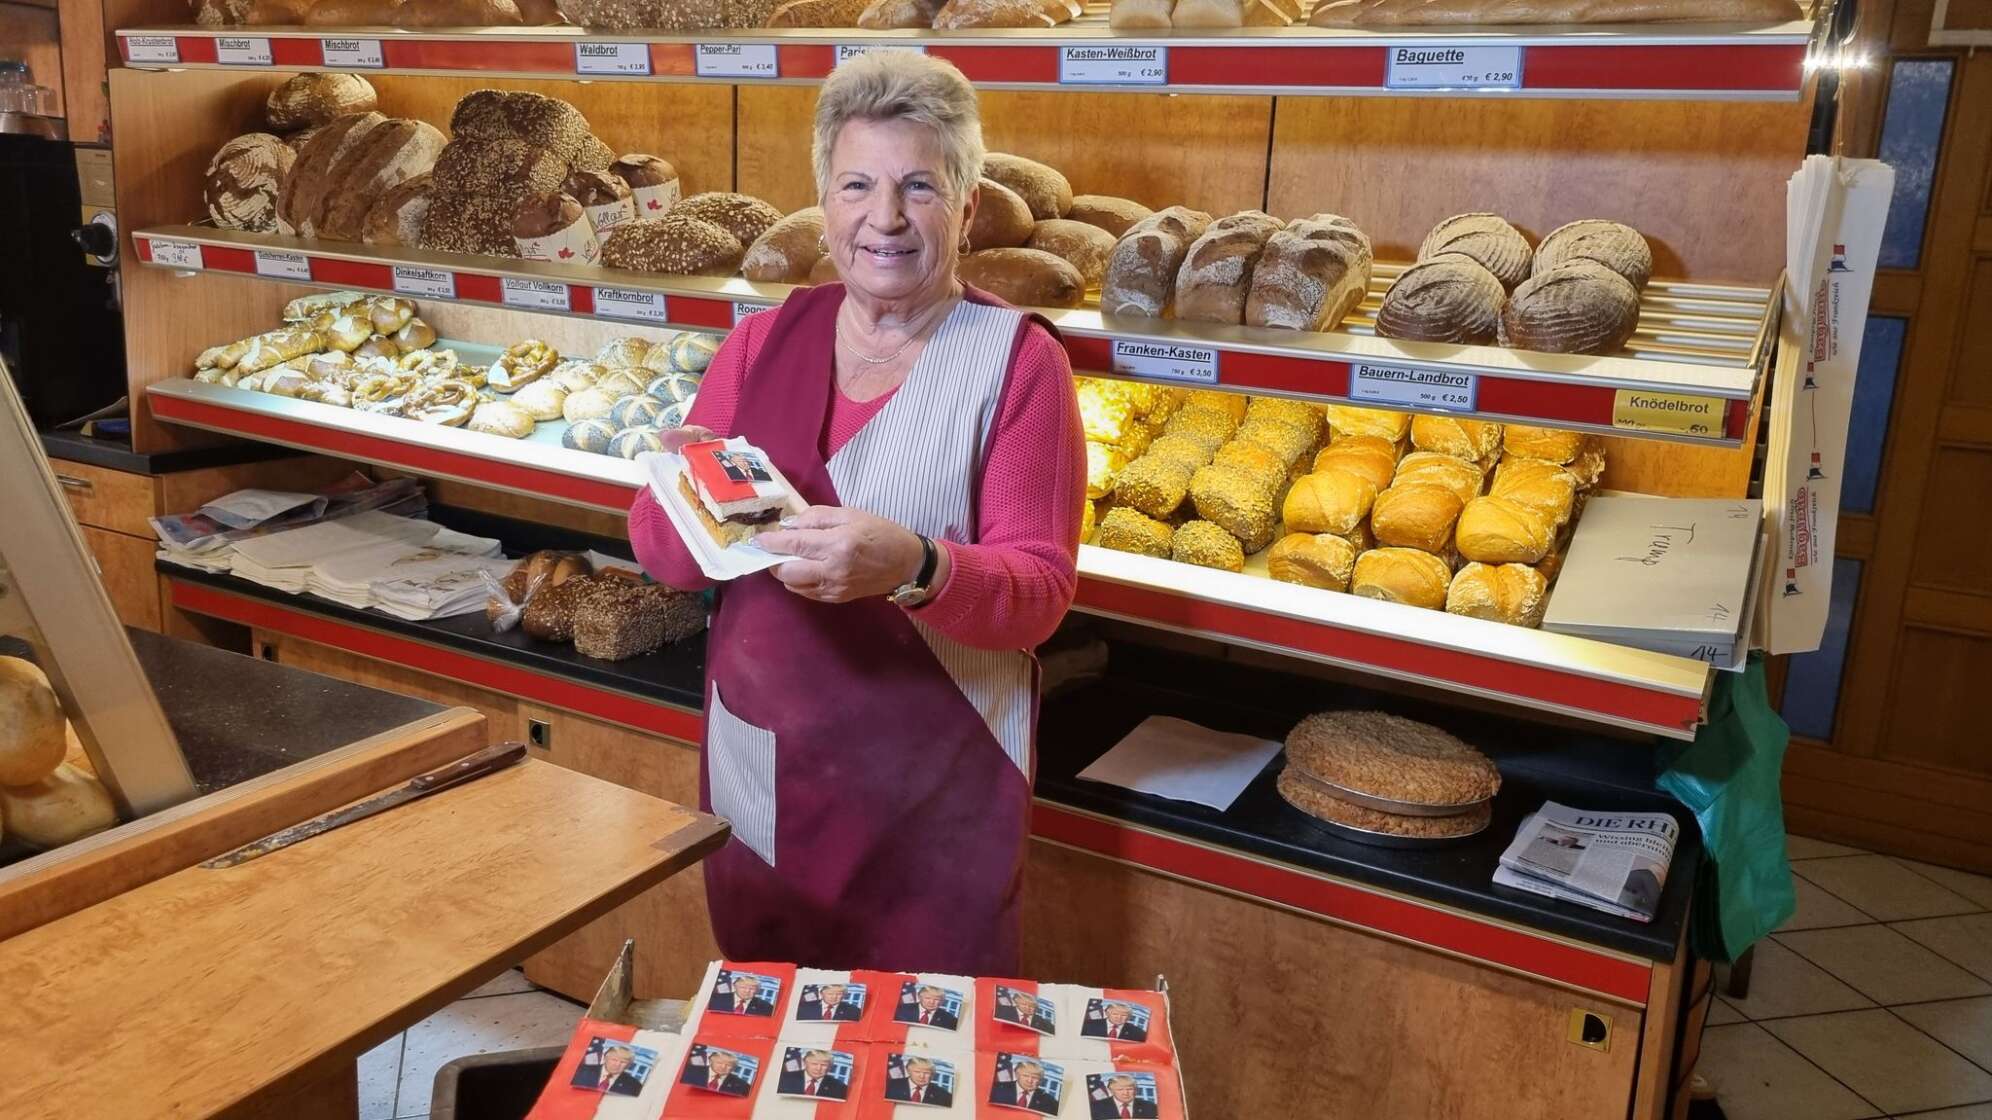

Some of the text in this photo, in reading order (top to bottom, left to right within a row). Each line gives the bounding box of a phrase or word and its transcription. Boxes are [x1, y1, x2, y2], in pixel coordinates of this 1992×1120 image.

[325, 40, 360, 49] Mischbrot
[579, 45, 618, 55] Waldbrot
[1066, 48, 1157, 60] Kasten-Weißbrot
[1396, 48, 1465, 64] Baguette
[1147, 69, 1163, 77] 2,90
[1485, 73, 1492, 81] €
[1493, 73, 1513, 82] 2,90
[395, 267, 447, 281] Dinkelsaftkorn
[533, 281, 564, 293] Vollkorn
[598, 288, 654, 303] Kraftkornbrot
[1117, 343, 1211, 361] Franken-Kasten
[1197, 369, 1212, 377] 3,50
[1359, 366, 1470, 386] Bauern-Landbrot
[1449, 394, 1468, 403] 2,50
[1629, 396, 1709, 414] Knödelbrot
[1613, 522, 1697, 567] Trump
[1706, 603, 1730, 622] 14
[1690, 645, 1729, 662] 14
[1575, 817, 1623, 829] DIE
